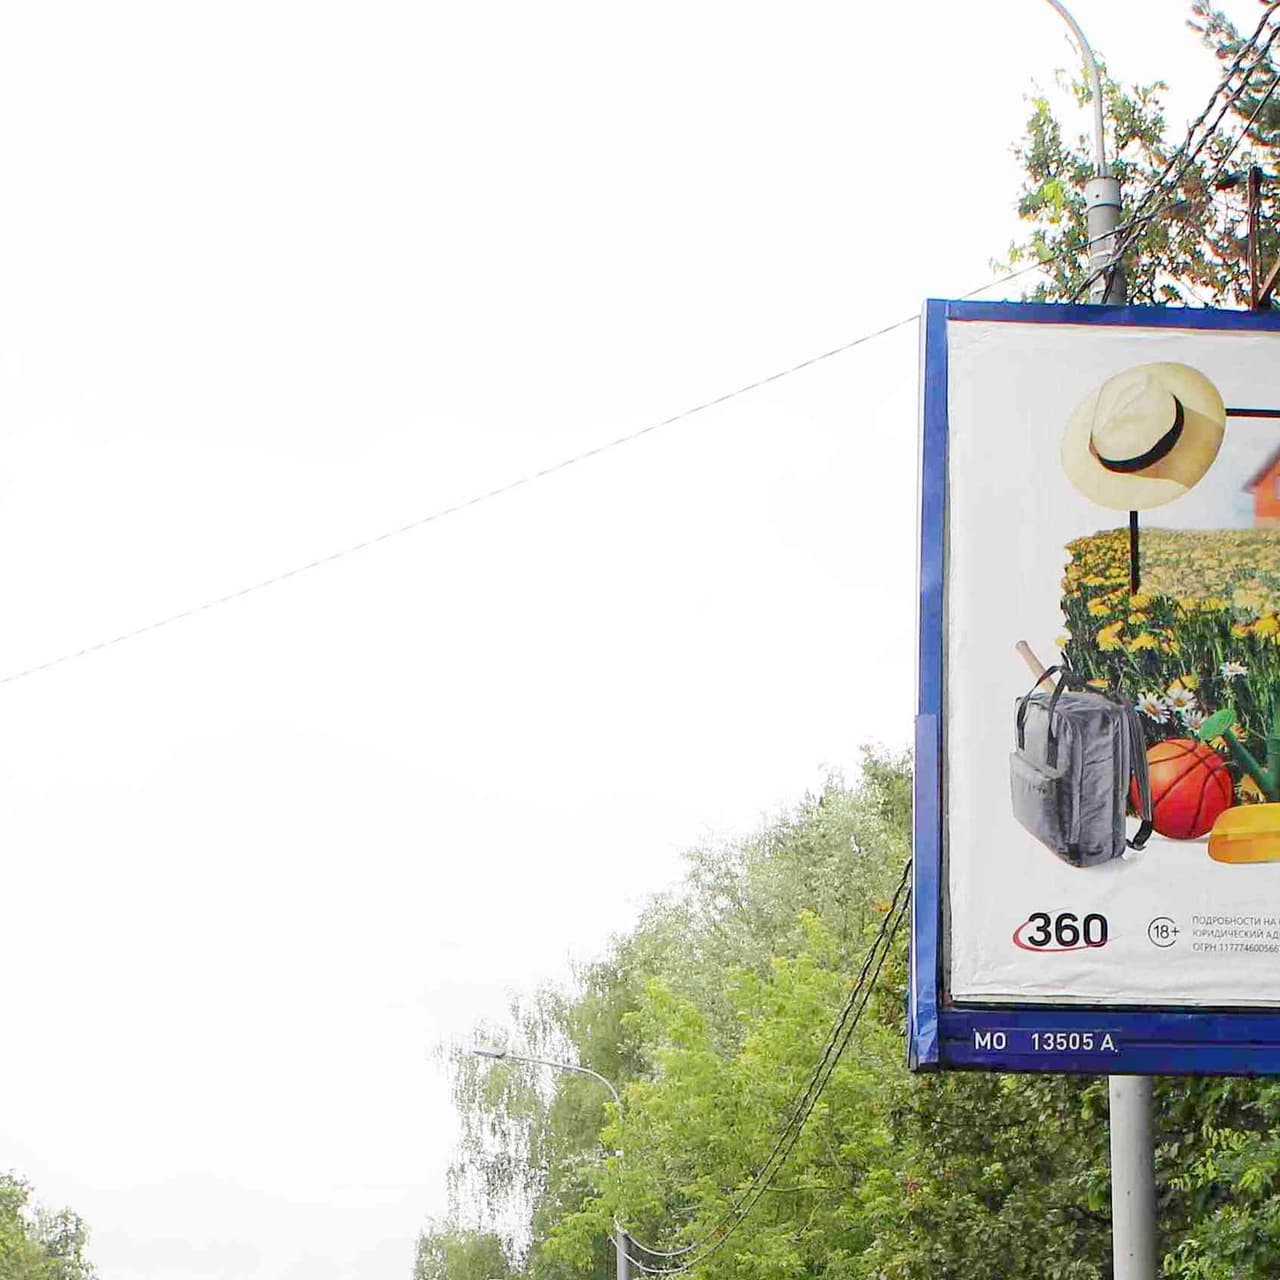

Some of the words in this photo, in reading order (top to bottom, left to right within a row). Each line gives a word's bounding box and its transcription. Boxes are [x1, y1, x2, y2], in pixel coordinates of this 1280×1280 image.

[1027, 911, 1109, 948] 360
[1192, 915, 1262, 927] ПОДРОБНОСТИ
[1263, 917, 1276, 927] НА
[1152, 923, 1180, 940] 18+
[1192, 928, 1264, 939] ЮРИДИЧЕСКИЙ
[1031, 1032, 1094, 1051] 13505
